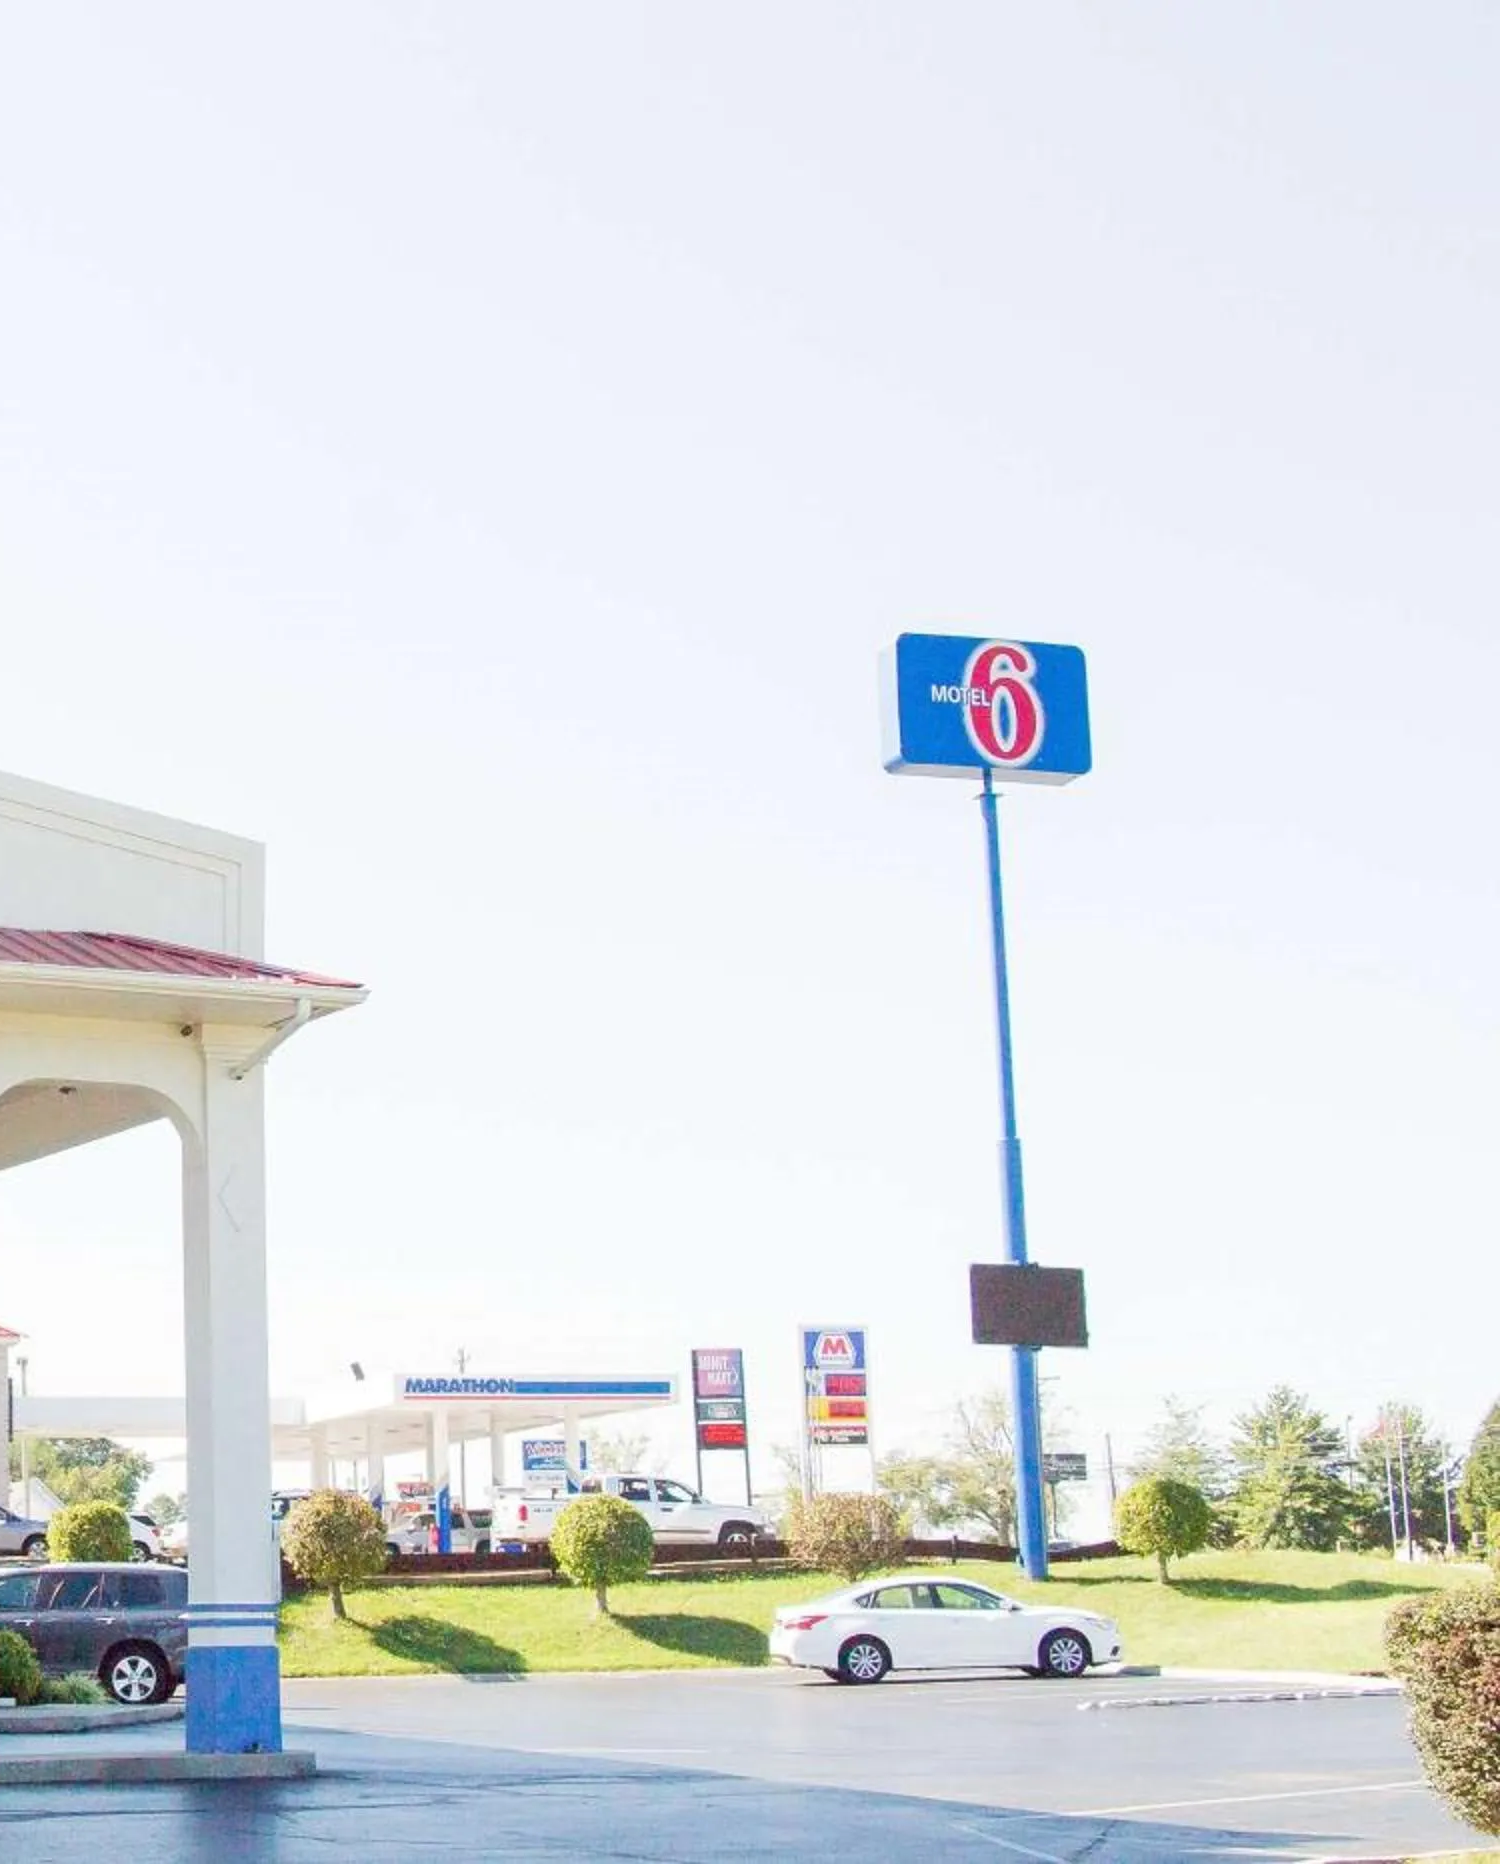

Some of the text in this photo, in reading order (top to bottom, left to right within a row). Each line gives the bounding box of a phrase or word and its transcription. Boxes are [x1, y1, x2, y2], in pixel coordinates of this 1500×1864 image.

[931, 644, 1039, 762] MOTEL 6
[405, 1378, 516, 1393] MARATHON
